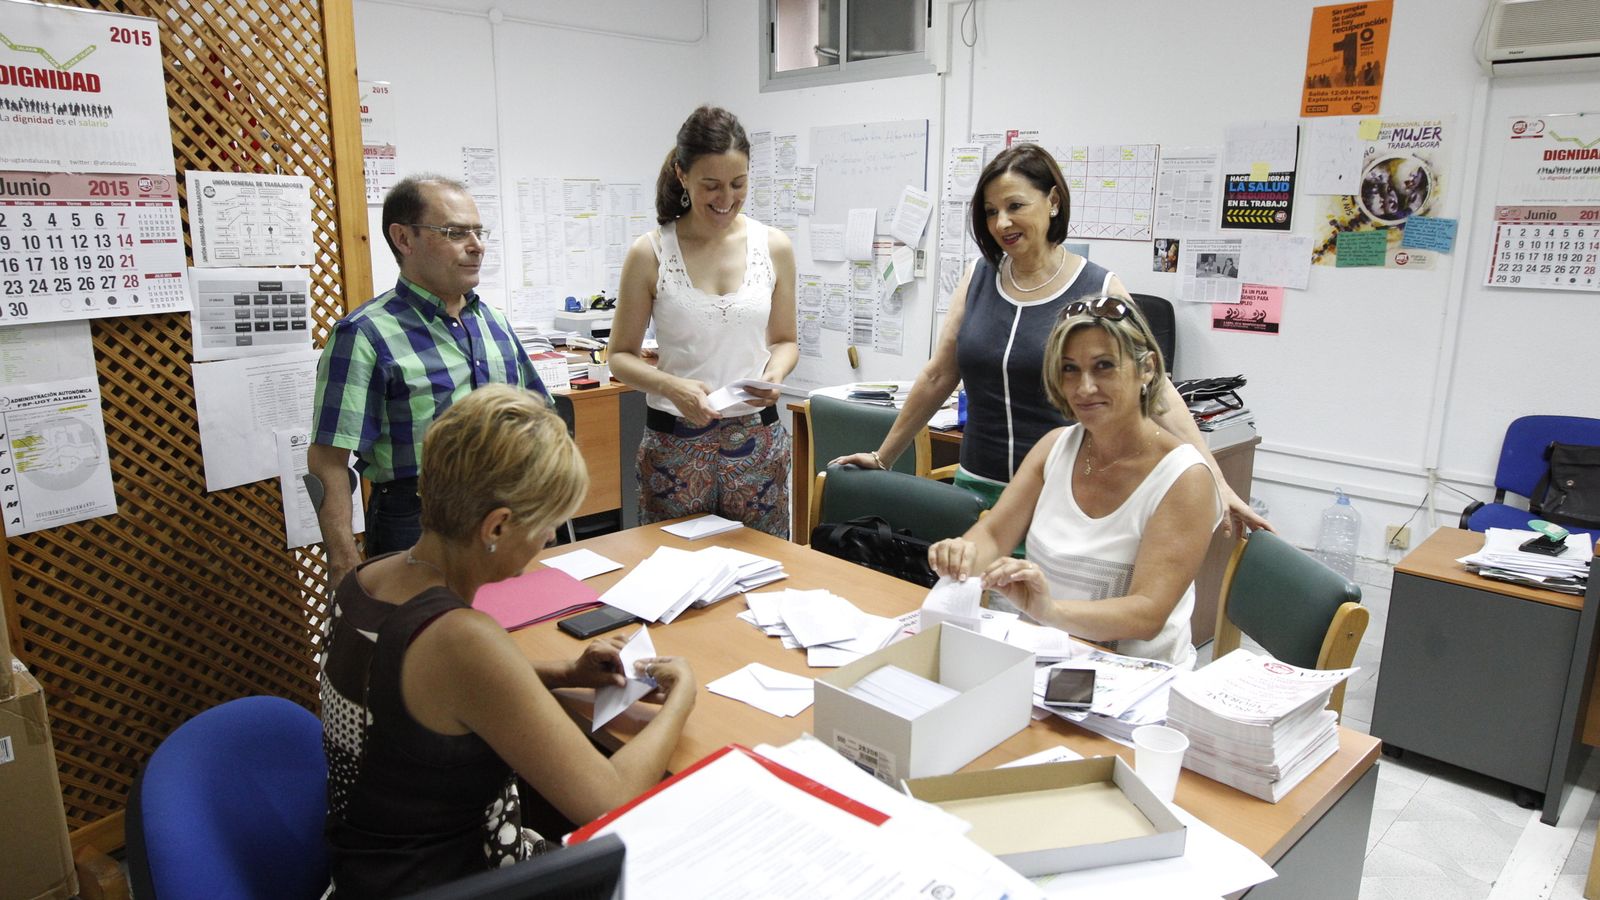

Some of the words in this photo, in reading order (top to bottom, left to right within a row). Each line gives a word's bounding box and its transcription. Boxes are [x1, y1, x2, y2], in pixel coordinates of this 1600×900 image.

[1332, 17, 1388, 34] recuperación
[110, 27, 152, 46] 2015
[0, 65, 101, 93] DIGNIDAD
[372, 86, 389, 94] 2015
[12, 114, 54, 125] dignidad
[56, 118, 66, 126] es
[68, 117, 77, 126] el
[78, 119, 109, 128] salario
[1391, 126, 1442, 141] MUJER
[1387, 141, 1440, 149] TRABAJADORA
[1543, 148, 1600, 161] DIGNIDA
[0, 178, 51, 196] Junio
[88, 180, 130, 196] 2015
[264, 181, 304, 189] TRABAJADORES
[1229, 182, 1246, 192] LA
[1248, 182, 1290, 192] SALUD
[0, 213, 7, 227] 2
[22, 212, 32, 227] 3
[47, 212, 57, 227] 4
[71, 212, 81, 227] 5
[95, 212, 104, 227] 6
[117, 212, 126, 226] 7
[1524, 209, 1557, 220] Junio
[1579, 210, 1600, 220] 201
[1507, 228, 1511, 236] 1
[1520, 228, 1526, 237] 2
[1534, 228, 1540, 237] 3
[1548, 229, 1555, 237] 4
[1563, 229, 1569, 237] 5
[1578, 229, 1584, 237] 6
[1593, 229, 1600, 238] 7
[0, 235, 11, 250] 9
[22, 235, 40, 249] 10
[46, 235, 63, 249] 11
[71, 234, 88, 249] 12
[94, 234, 111, 248] 13
[117, 233, 134, 247] 14
[1504, 240, 1510, 248] 8
[1518, 240, 1524, 248] 9
[1531, 241, 1540, 249] 10
[1560, 241, 1570, 249] 12
[1574, 241, 1584, 249] 13
[1589, 242, 1600, 250] 14
[1, 258, 19, 273] 16
[25, 257, 43, 271] 17
[50, 256, 68, 271] 18
[74, 255, 92, 270] 19
[97, 254, 114, 269] 20
[119, 254, 135, 268] 21
[1501, 252, 1511, 260] 15
[1515, 252, 1525, 260] 16
[1543, 253, 1553, 261] 18
[1557, 253, 1568, 261] 19
[1571, 254, 1583, 262] 20
[1586, 254, 1597, 262] 21
[1498, 263, 1509, 271] 22
[1512, 264, 1523, 272] 23
[1526, 264, 1537, 272] 24
[1540, 265, 1551, 273] 25
[1554, 265, 1566, 274] 26
[1569, 266, 1581, 274] 27
[1584, 266, 1595, 275] 28
[3, 280, 23, 295] 23
[29, 279, 48, 294] 24
[54, 278, 72, 292] 25
[77, 276, 95, 291] 26
[100, 275, 116, 290] 27
[122, 274, 139, 288] 28
[1510, 275, 1521, 283] 30
[8, 302, 28, 317] 30
[11, 392, 57, 404] ADMINISTRACIÓN
[58, 388, 93, 396] AUTONÓMICA
